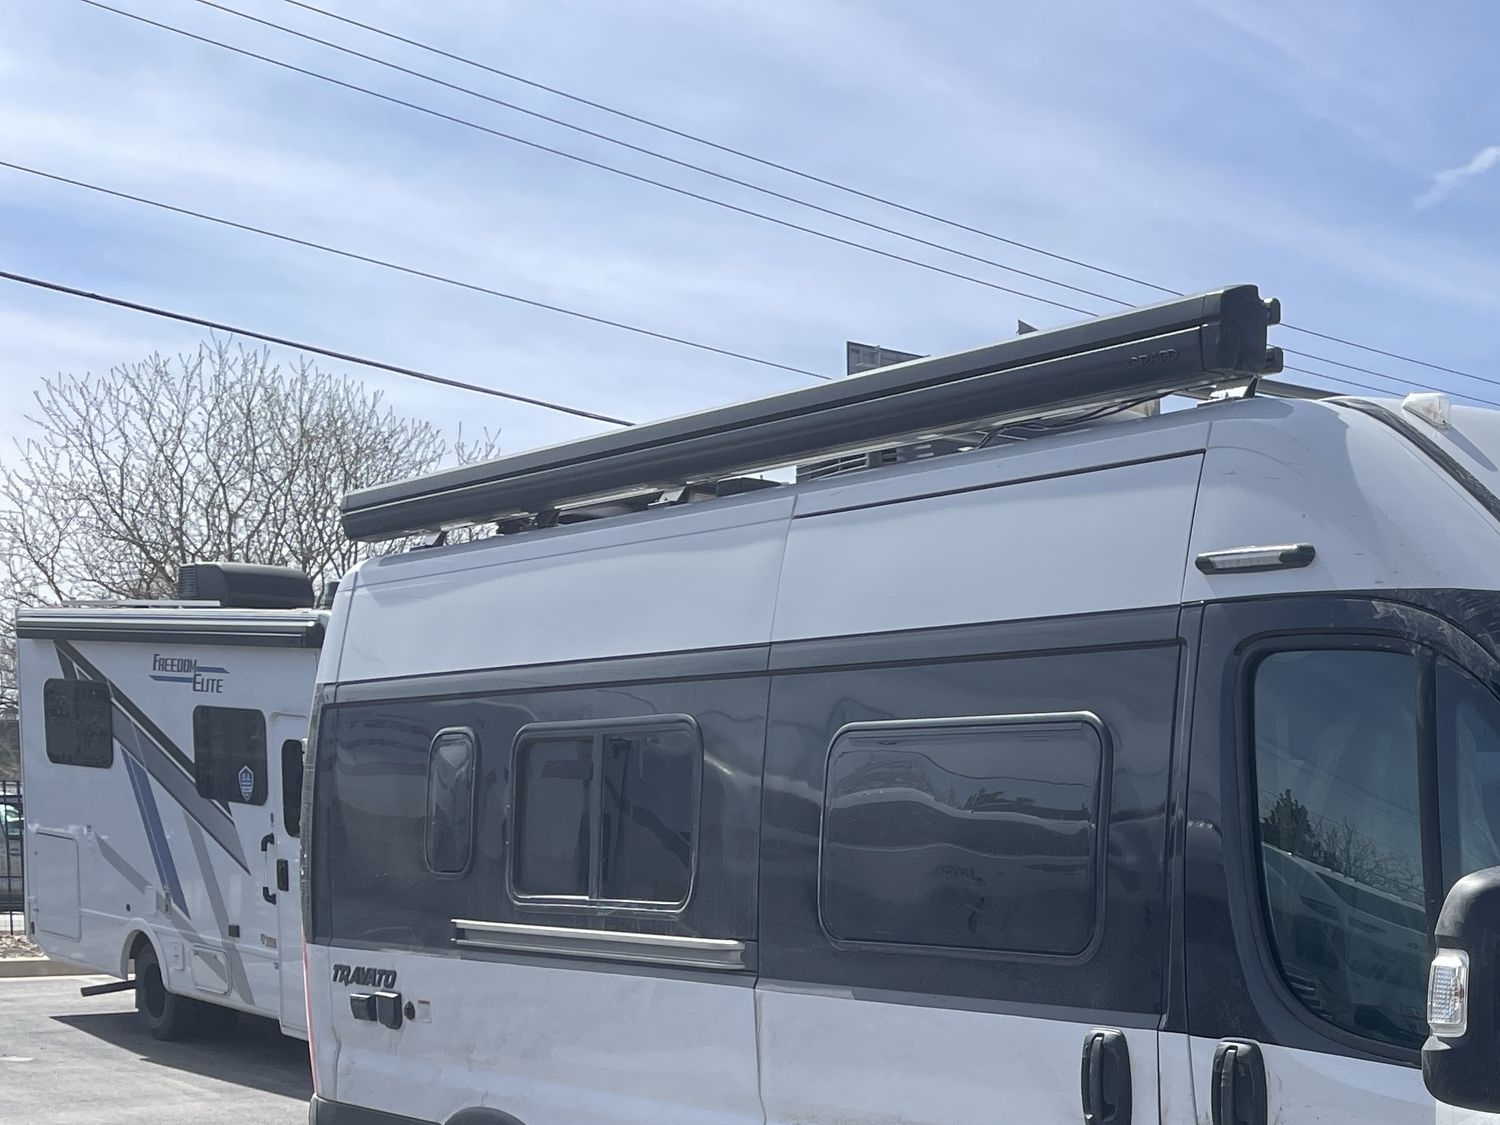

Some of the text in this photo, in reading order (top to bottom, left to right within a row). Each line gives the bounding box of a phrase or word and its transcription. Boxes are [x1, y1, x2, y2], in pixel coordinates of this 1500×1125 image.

[152, 653, 197, 674] FREEDOM
[192, 673, 224, 693] ELITE
[332, 963, 398, 989] TRAVATO
